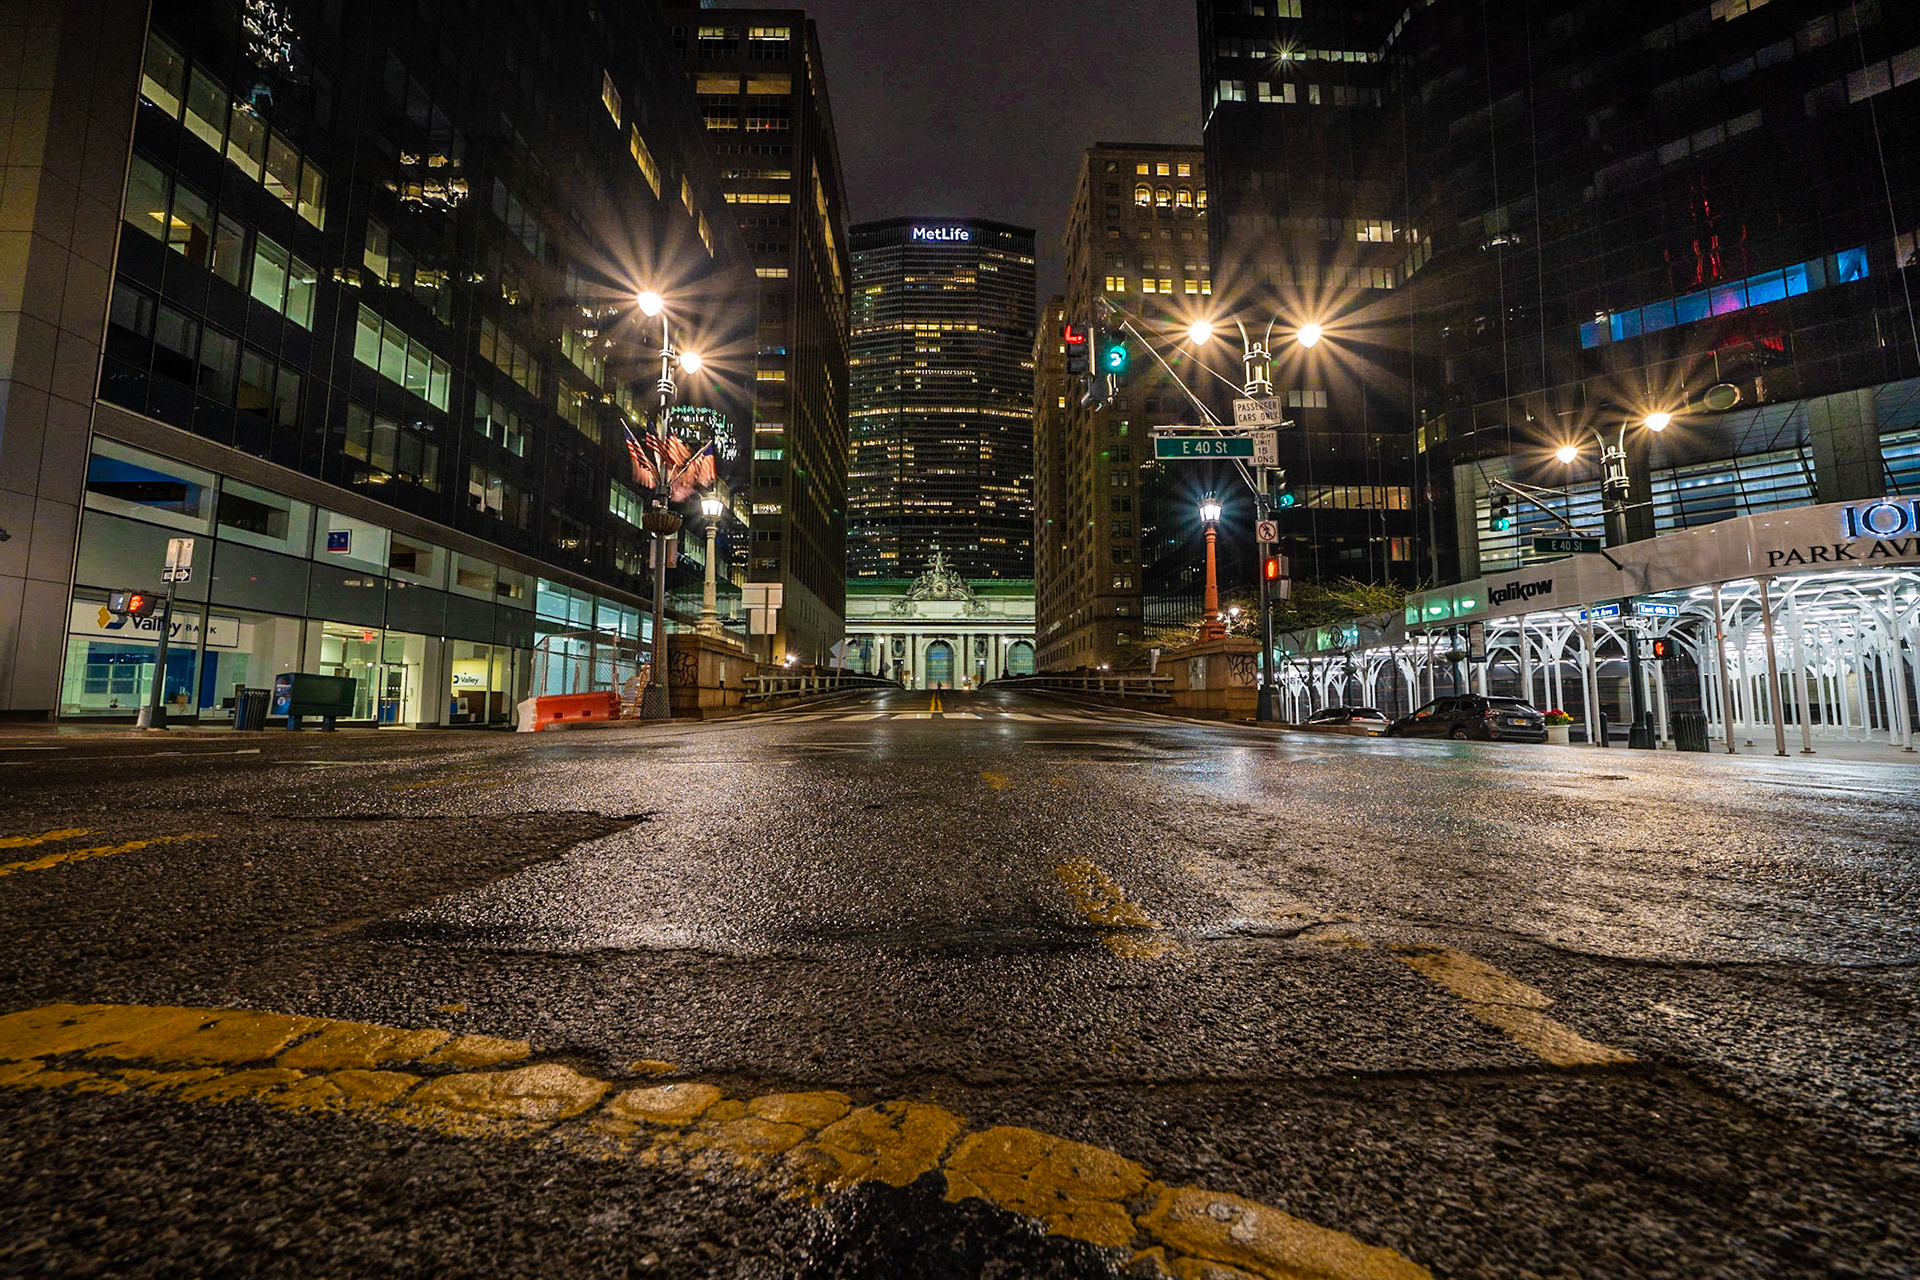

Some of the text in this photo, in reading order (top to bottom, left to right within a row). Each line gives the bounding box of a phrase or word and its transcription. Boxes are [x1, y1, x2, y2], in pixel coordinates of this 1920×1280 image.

[912, 227, 969, 241] MetLife
[1237, 401, 1277, 412] PASSENGER
[1238, 411, 1279, 422] CARS ONLY
[1182, 441, 1228, 454] E 40 St
[1258, 447, 1269, 455] 15
[1551, 540, 1583, 551] E 40 St
[1766, 542, 1861, 569] PARK
[1487, 579, 1553, 607] kalikow
[132, 615, 217, 637] Vally BAK
[460, 676, 480, 685] Valley
